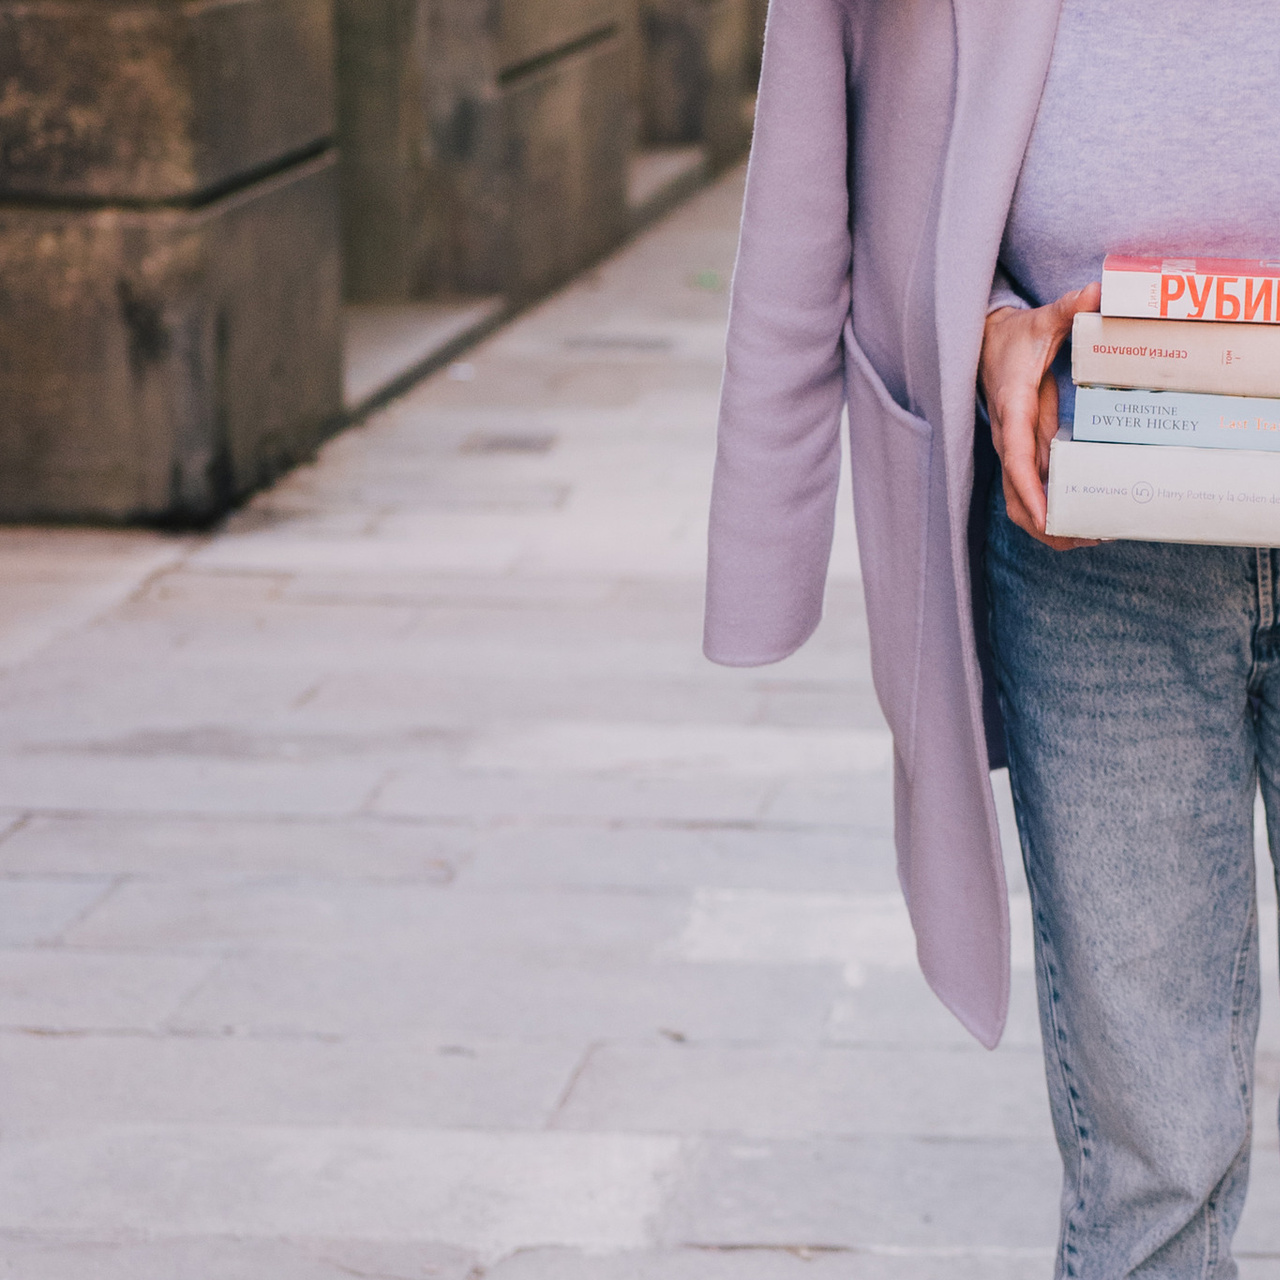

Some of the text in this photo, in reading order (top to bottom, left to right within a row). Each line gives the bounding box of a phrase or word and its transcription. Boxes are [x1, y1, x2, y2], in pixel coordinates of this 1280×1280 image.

[1092, 344, 1188, 359] СЕРГЕЙ ДОВЛАТОВ
[1114, 403, 1178, 416] CHRISTINE
[1092, 414, 1200, 432] DWYER HICKEY
[1219, 416, 1248, 430] Last
[1083, 486, 1128, 496] ROWLING
[1157, 488, 1184, 501] Harry
[1187, 490, 1215, 500] Potter
[1227, 490, 1235, 502] la
[1237, 492, 1268, 503] Orden
